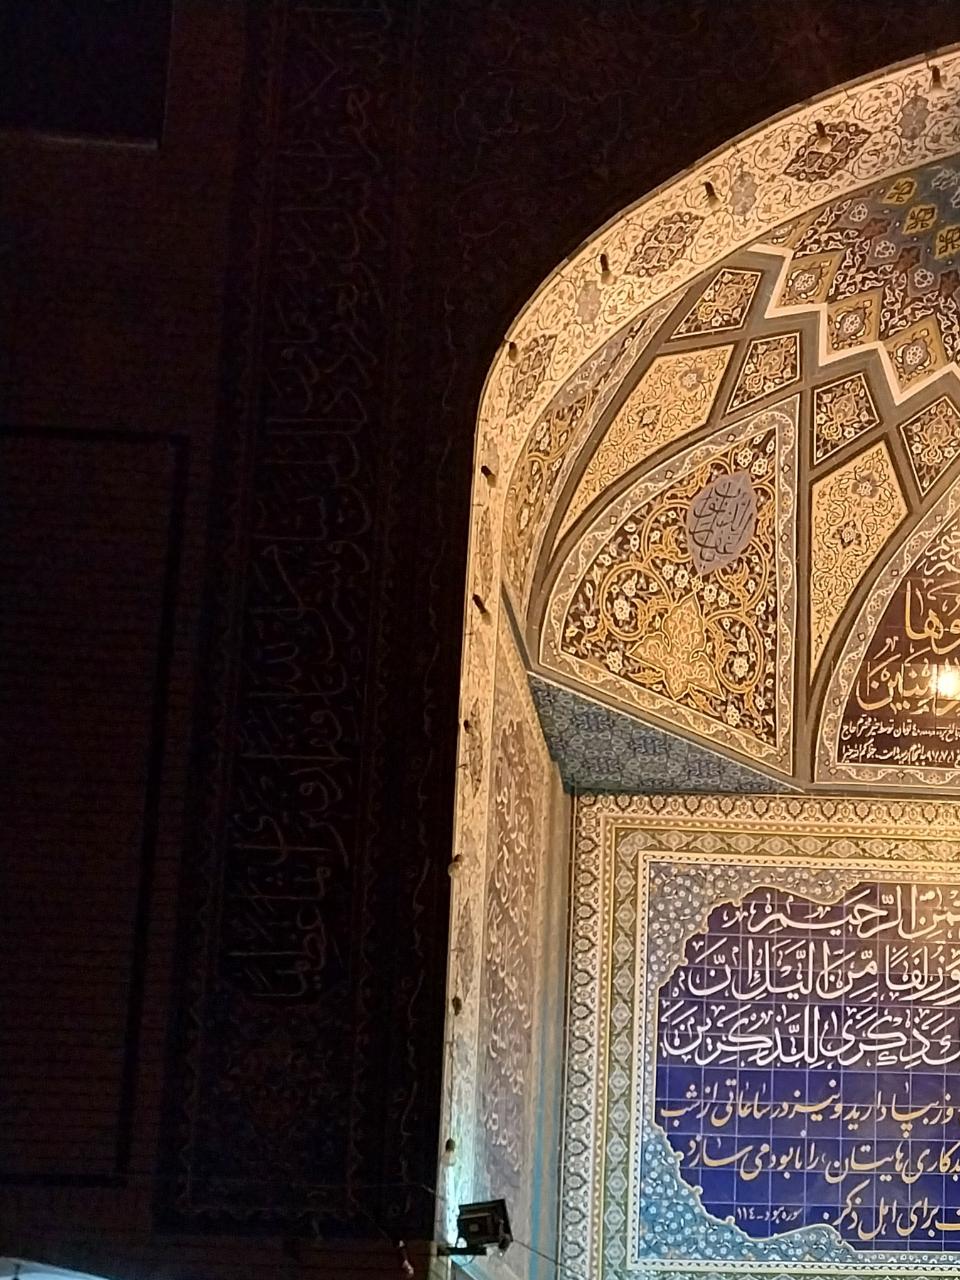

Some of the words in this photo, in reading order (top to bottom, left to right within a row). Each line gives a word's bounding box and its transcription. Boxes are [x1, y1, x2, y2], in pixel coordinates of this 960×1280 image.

[660, 1083, 702, 1127] شب
[696, 1081, 719, 1119] از
[842, 1089, 887, 1131] دارید
[687, 1134, 755, 1169] سازد
[805, 1141, 820, 1171] را
[857, 1196, 898, 1241] اهل
[896, 1197, 940, 1238] برای
